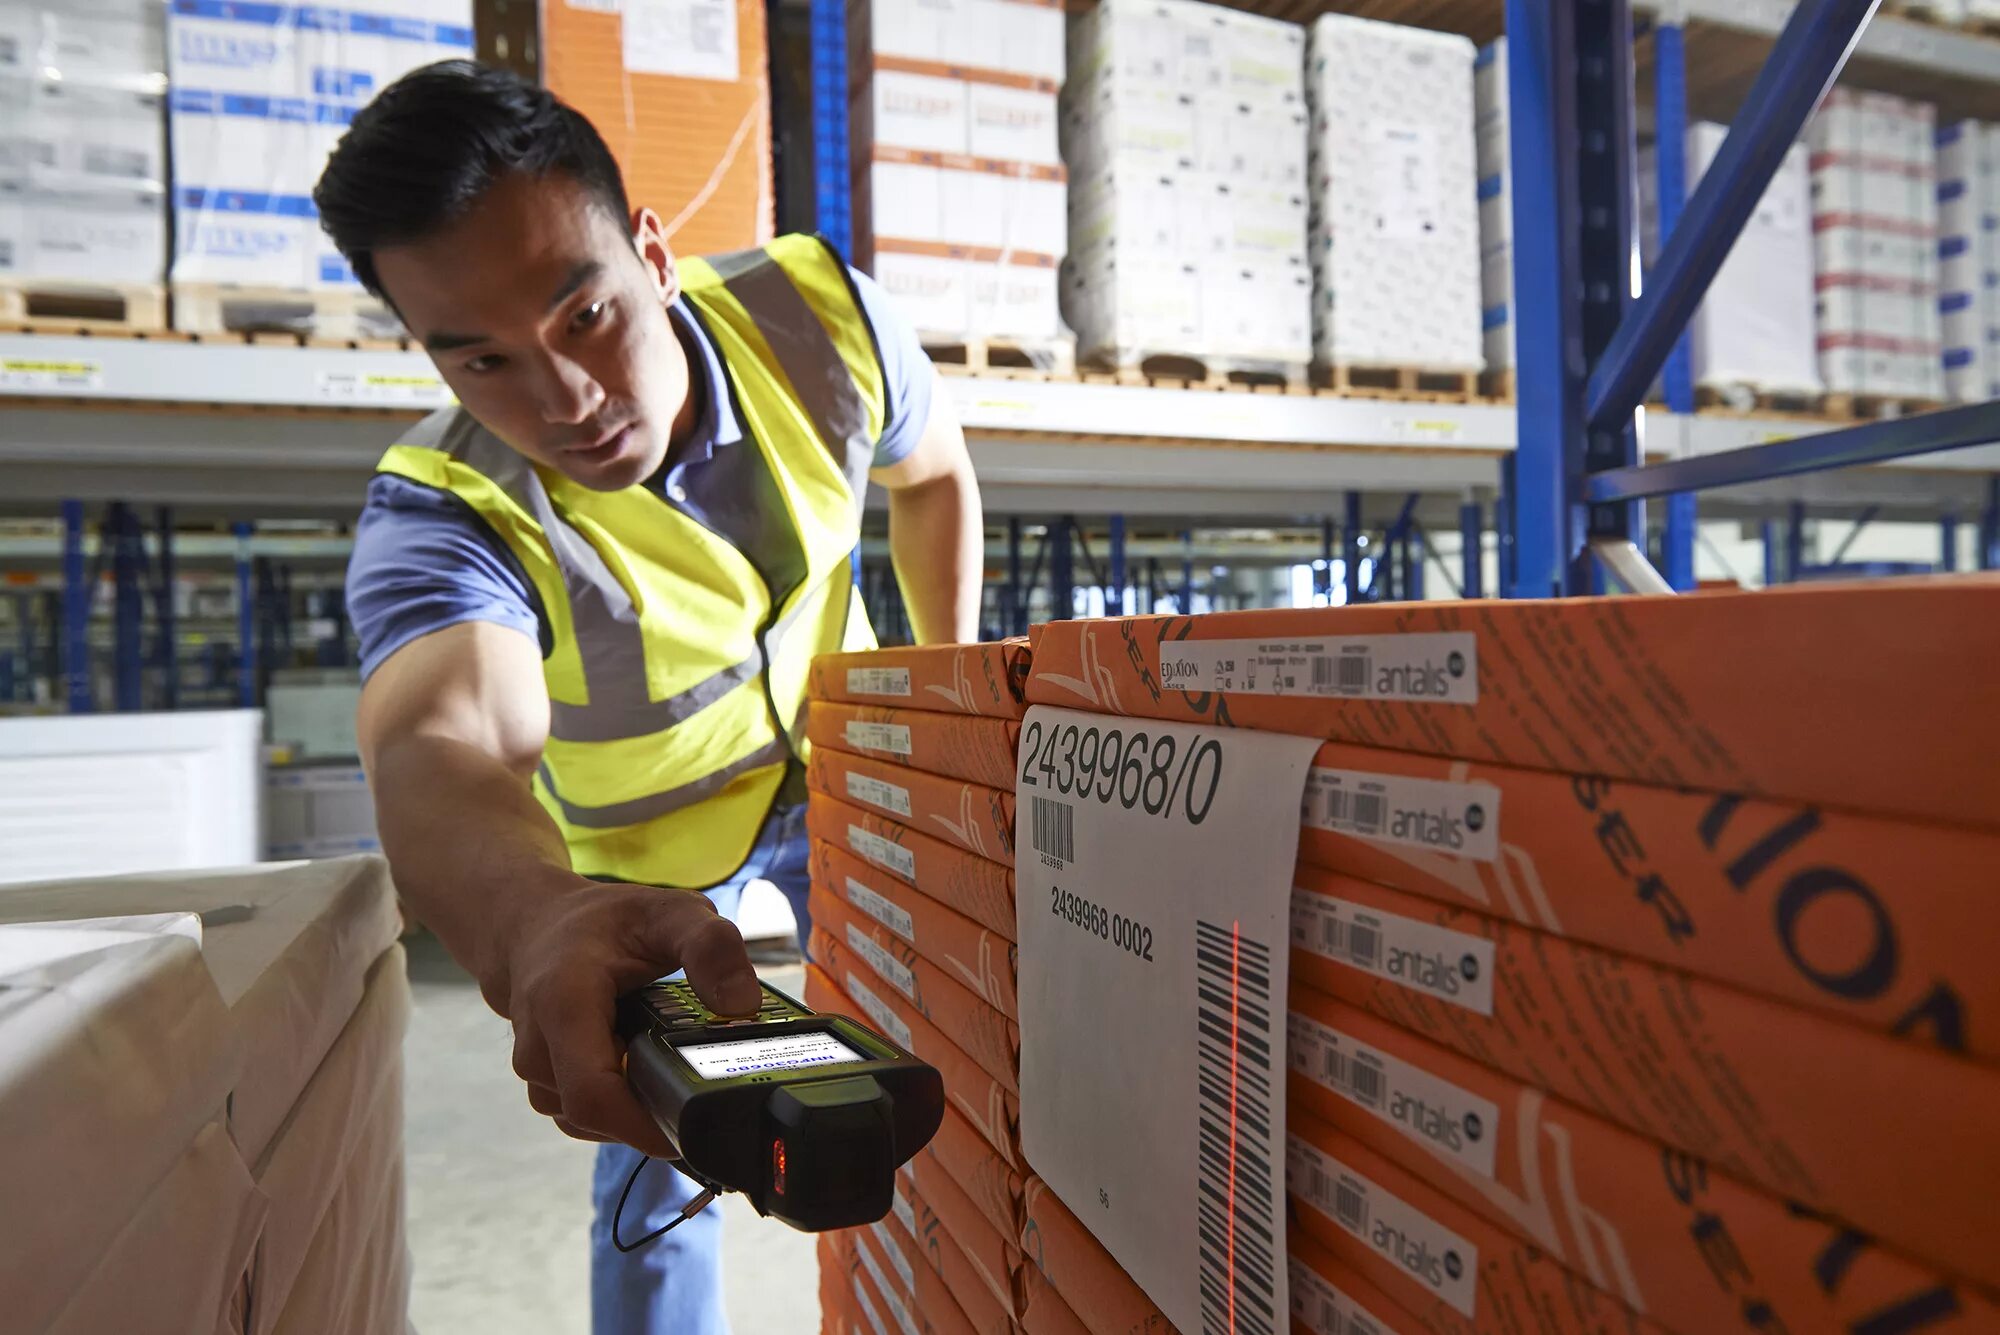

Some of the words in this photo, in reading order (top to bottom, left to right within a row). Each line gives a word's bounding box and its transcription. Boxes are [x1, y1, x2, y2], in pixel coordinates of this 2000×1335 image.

[1377, 659, 1449, 697] antalis
[1022, 721, 1223, 825] 2439968/0
[1391, 807, 1464, 850] antalis
[1040, 853, 1064, 871] 2439968
[1051, 885, 1109, 940] 2439968
[1113, 913, 1153, 962] 0002
[1387, 946, 1459, 996] antalis
[1390, 1089, 1462, 1153] antalis
[1100, 1187, 1109, 1209] 56
[1372, 1217, 1442, 1288] antalis
